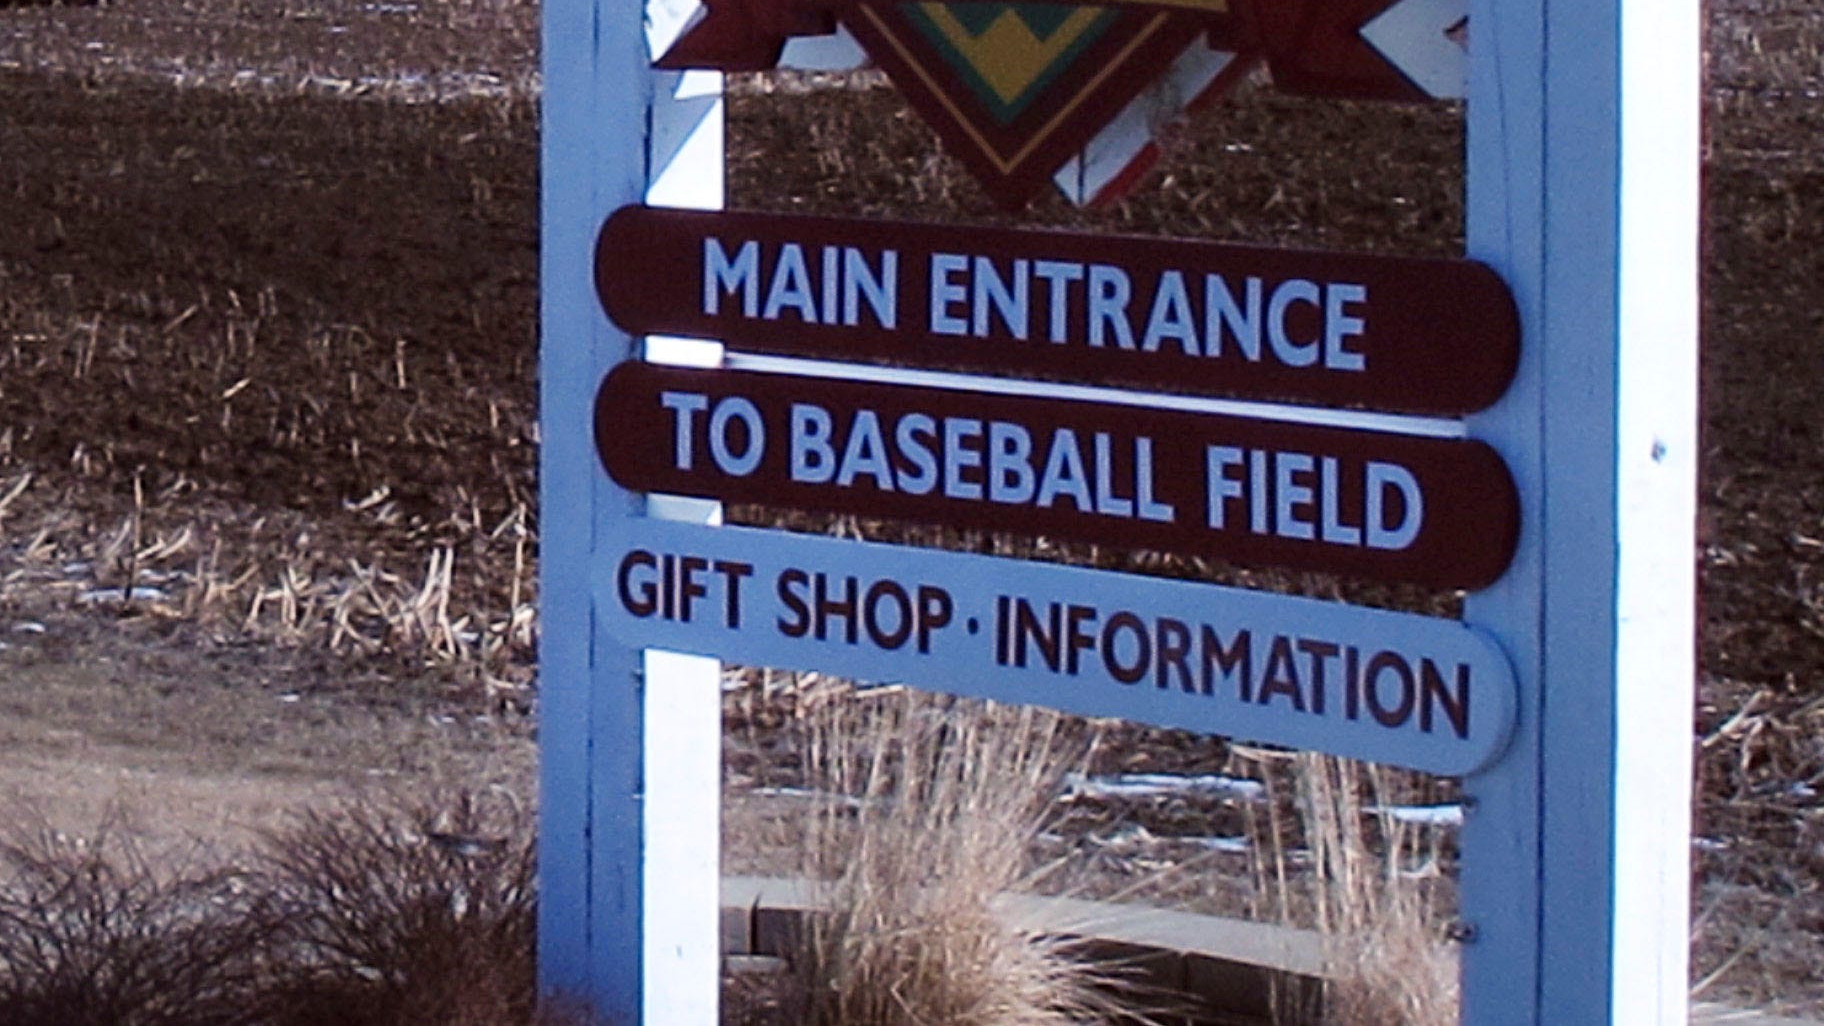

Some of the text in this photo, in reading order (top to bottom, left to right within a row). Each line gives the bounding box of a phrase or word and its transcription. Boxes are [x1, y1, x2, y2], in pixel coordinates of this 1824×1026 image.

[702, 238, 1367, 373] MAIN ENTRANCE
[661, 391, 1424, 551] TO BASEBALL FIELD
[615, 548, 1471, 740] GIFT SHOP INFORMATION
